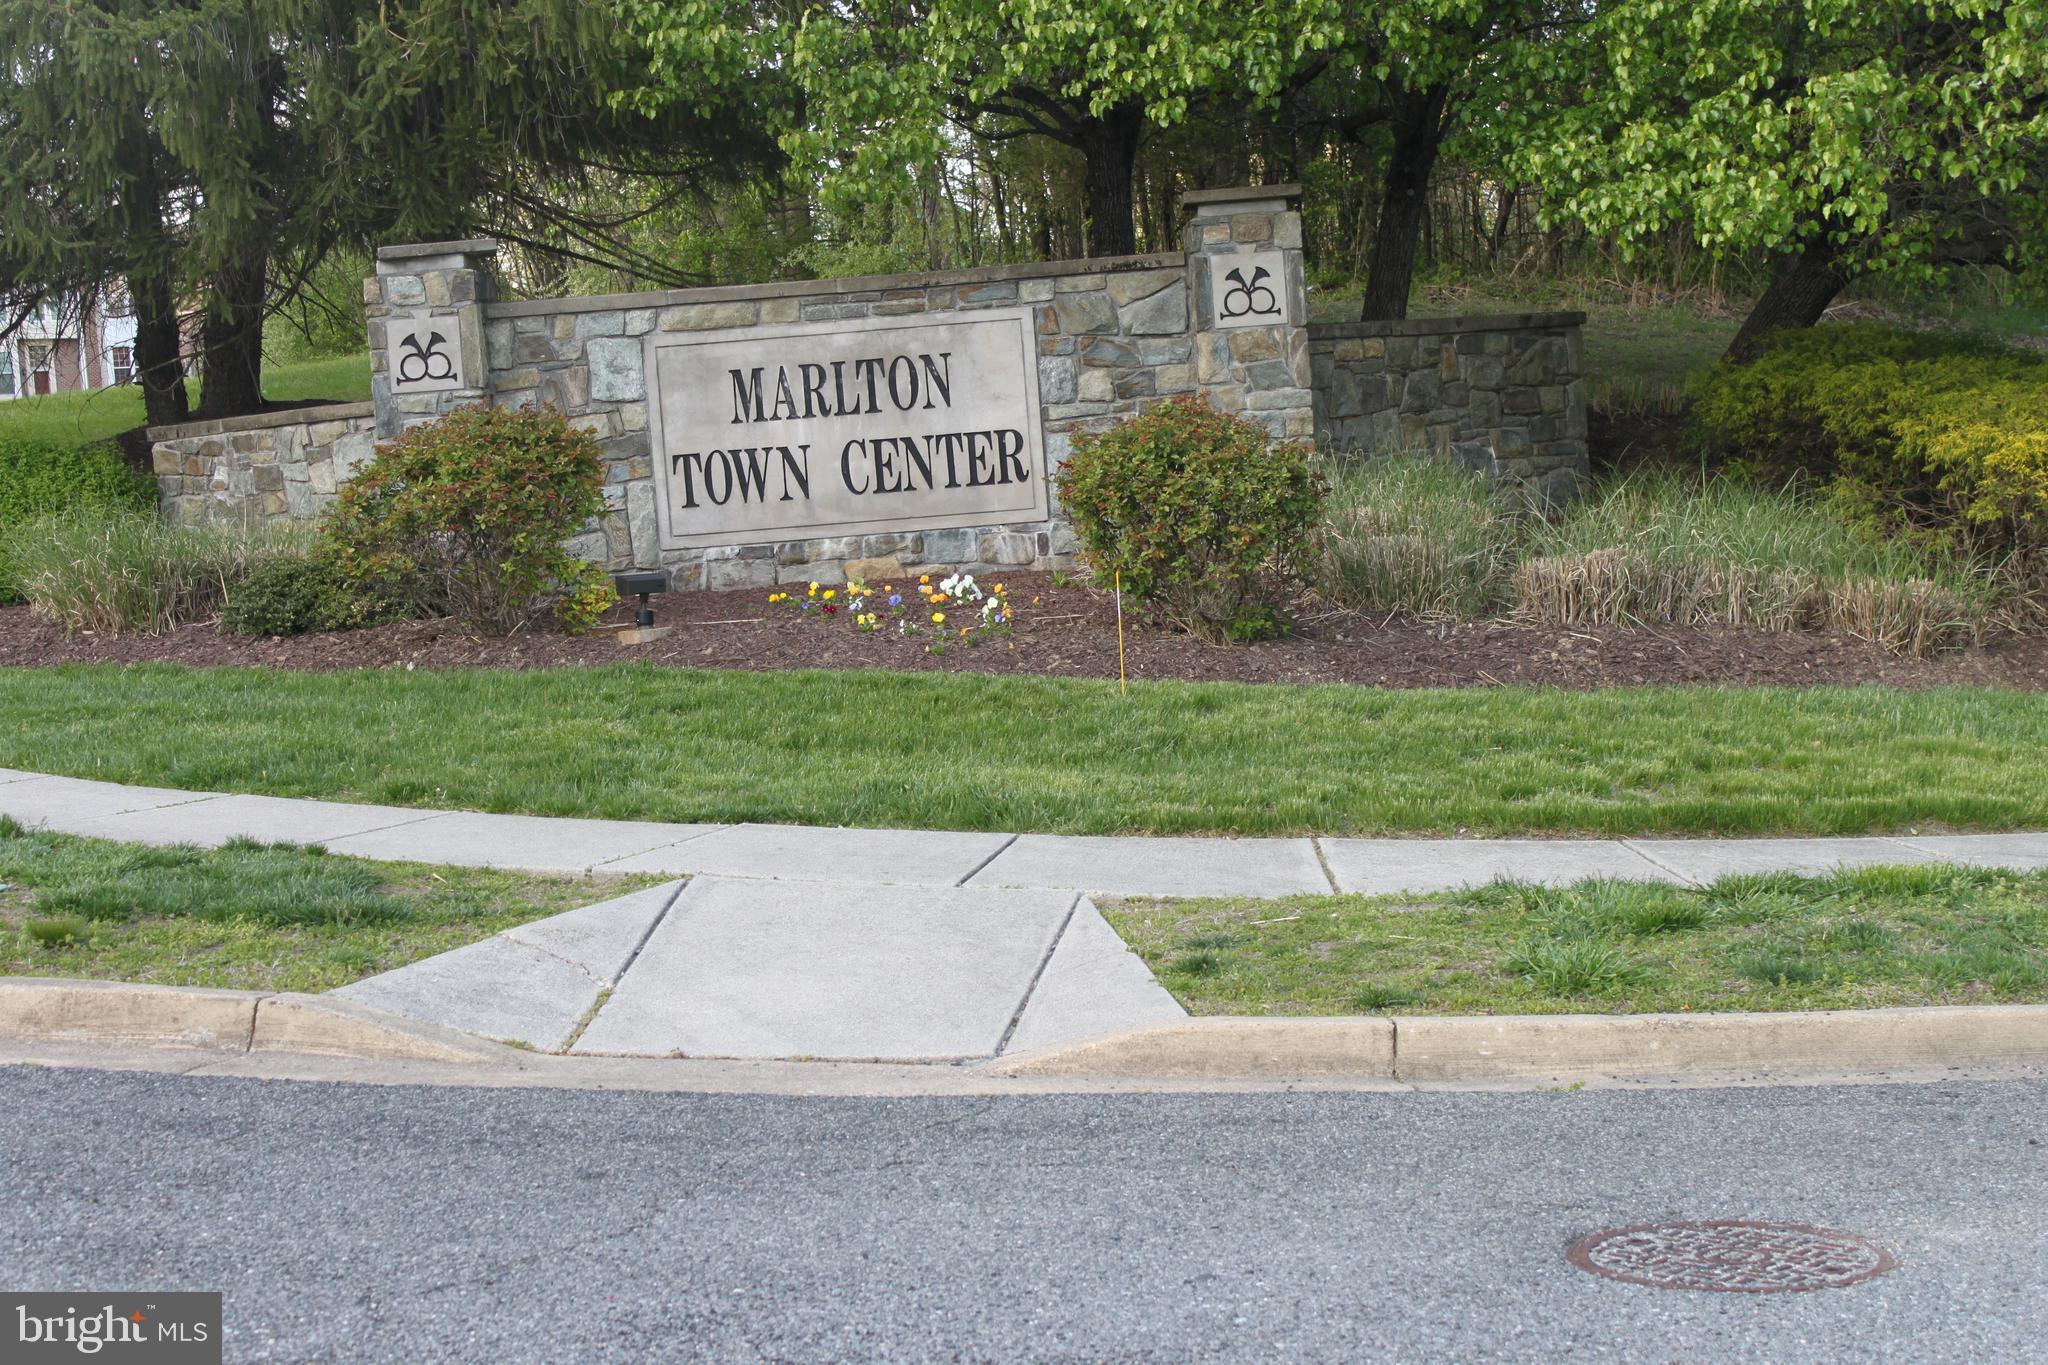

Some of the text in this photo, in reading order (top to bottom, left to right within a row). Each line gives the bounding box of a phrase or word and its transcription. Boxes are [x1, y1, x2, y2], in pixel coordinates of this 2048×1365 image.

[728, 352, 952, 425] MARLTON
[672, 428, 1030, 509] TOWN CENTER
